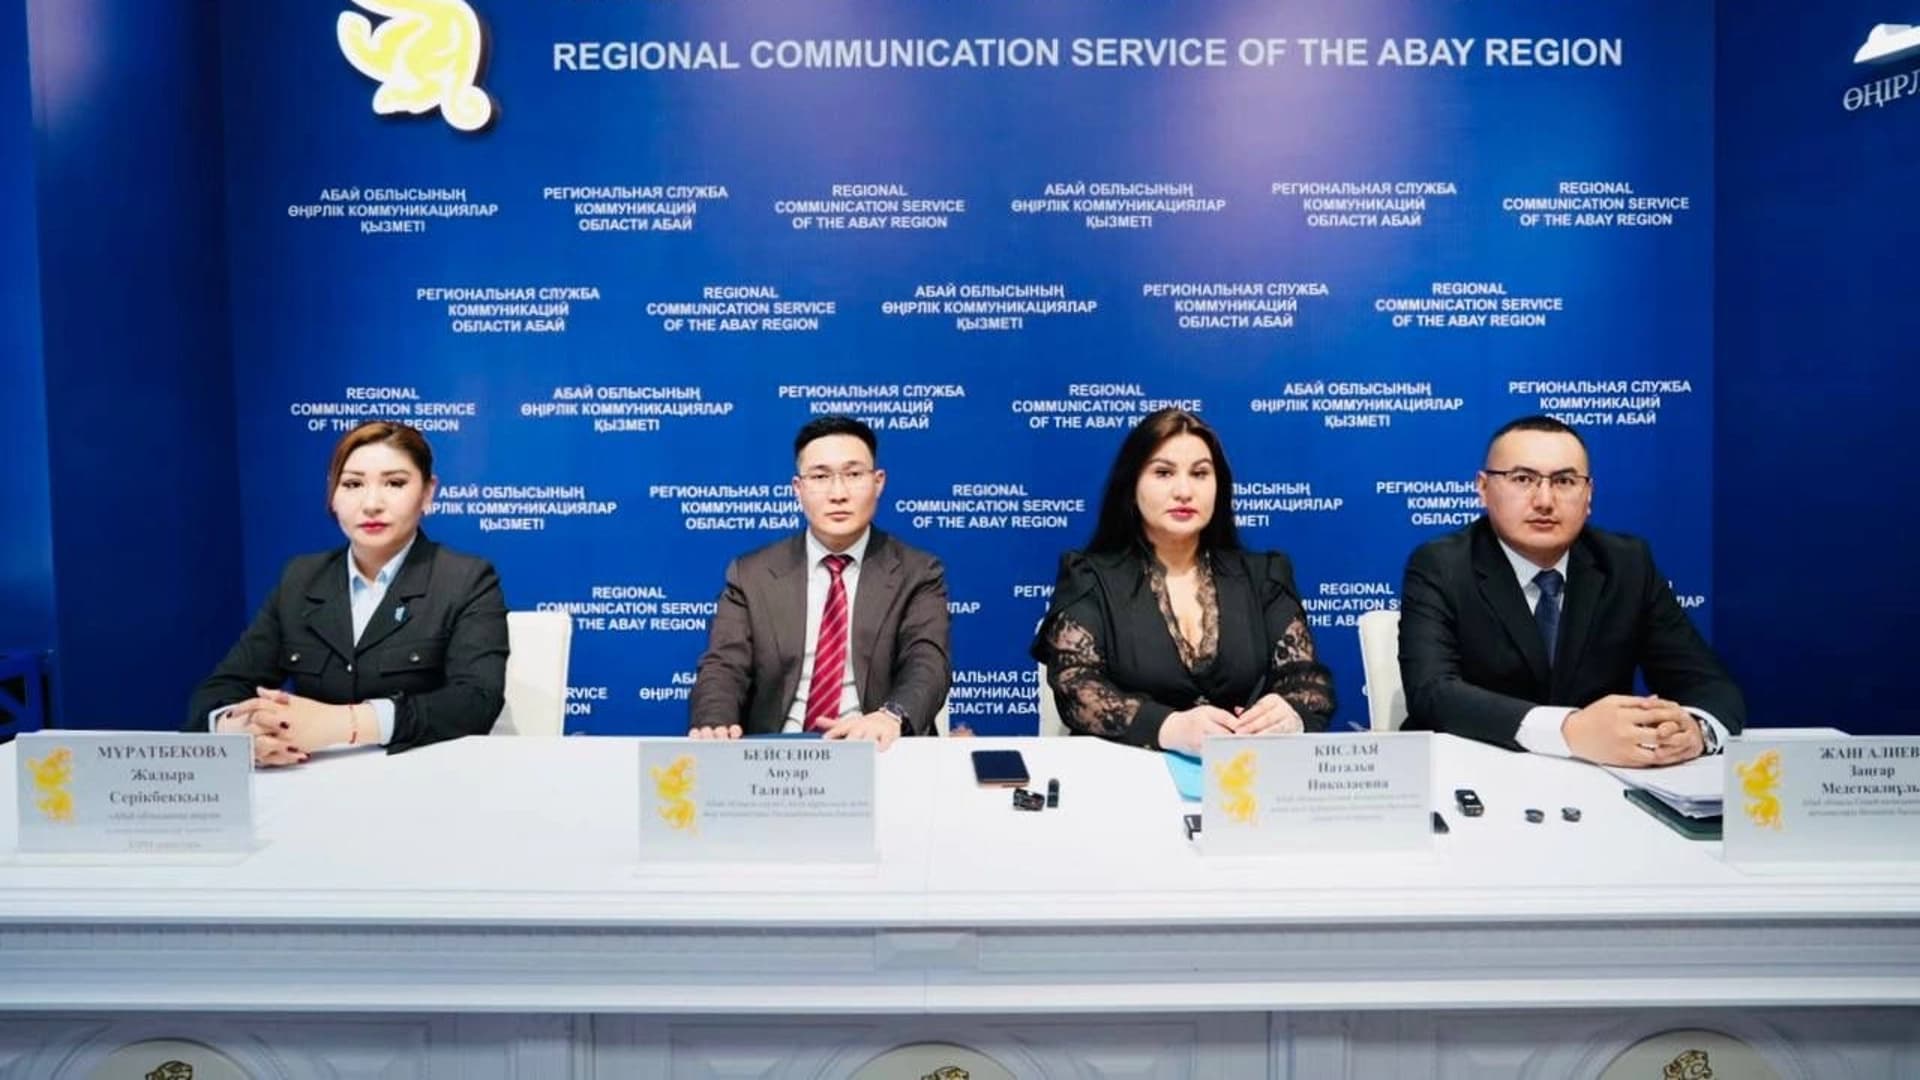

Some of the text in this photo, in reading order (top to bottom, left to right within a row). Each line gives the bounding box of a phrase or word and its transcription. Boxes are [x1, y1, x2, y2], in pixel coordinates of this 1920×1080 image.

[553, 37, 1622, 72] REGIONAL COMMUNICATION SERVICE OF THE ABAY REGION
[320, 187, 466, 202] АБАЙ ОБЛЫСЫНЫҢ
[544, 185, 728, 200] РЕГИОНАЛЬНАЯ СЛУЖБА
[832, 184, 907, 196] REGIONAL
[1044, 181, 1193, 197] АБАЙ ОБЛЫСЫНЫҢ
[1272, 182, 1457, 195] РЕГИОНАЛЬНАЯ СЛУЖБА
[1559, 182, 1633, 194] REGIONAL
[288, 204, 498, 218] ӨҢІРЛІК КОММУНИКАЦИЯЛАР
[575, 202, 696, 215] КОММУНИКАЦИЙ
[775, 200, 965, 213] COMMUNICATION SERVICE
[1011, 199, 1226, 214] ӨҢІРЛІК КОММУНИКАЦИЯЛАР
[1304, 199, 1425, 211] КОММУНИКАЦИЙ
[1502, 197, 1689, 211] COMMUNICATION SERVICE
[579, 216, 693, 231] ОБЛАСТИ АБАЙ
[792, 216, 948, 229] OF THE ABAY REGION
[1086, 216, 1152, 229] ҚЫЗМЕТІ
[1307, 212, 1422, 226] ОБЛАСТИ АБАЙ
[1520, 213, 1672, 227] OF THE ABAY REGION
[361, 221, 425, 234] ҚЫЗМЕТІ
[417, 287, 600, 301] РЕГИОНАЛЬНАЯ СЛУЖБА
[703, 286, 778, 298] REGIONAL
[914, 283, 1064, 298] АБАЙ ОБЛЫСЫНЫҢ
[1143, 283, 1329, 297] РЕГИОНАЛЬНАЯ СЛУЖБА
[1432, 282, 1507, 295] REGIONAL
[448, 302, 569, 316] КОММУНИКАЦИЙ
[646, 301, 836, 316] COMMUNICATION SERVICE
[881, 300, 1098, 316] ӨҢІРЛІК КОММУНИКАЦИЯЛАР
[1175, 300, 1296, 312] КОММУНИКАЦИЙ
[1374, 297, 1563, 312] COMMUNICATION SERVICE
[452, 317, 565, 333] ОБЛАСТИ АБАЙ
[664, 318, 818, 331] OF THE ABAY REGION
[956, 317, 1023, 332] ҚЫЗМЕТІ
[1179, 313, 1293, 328] ОБЛАСТИ АБАЙ
[1392, 314, 1546, 328] OF THE ABAY REGION
[346, 387, 420, 399] REGIONAL
[553, 384, 701, 401] АБАЙ ОБЛЫСЫНЫҢ
[778, 384, 966, 398] РЕГИОНАЛЬНАЯ СЛУЖБА
[1069, 384, 1145, 396] REGIONAL
[1284, 380, 1432, 396] АБАЙ ОБЛЫСЫНЫҢ
[1508, 380, 1692, 394] РЕГИОНАЛЬНАЯ СЛУЖБА
[810, 399, 933, 414] КОММУНИКАЦИЙ
[1012, 400, 1136, 412] COMMUNICATION
[1250, 398, 1464, 414] ӨҢІРЛІК КОММУНИКАЦИЯЛАР
[1540, 394, 1660, 409] КОММУНИКАЦИЙ
[290, 402, 478, 416] COMMUNICATION SERVICE
[520, 402, 734, 418] ӨҢІРЛІК КОММУНИКАЦИЯЛАР
[888, 416, 930, 430] АБАЙ
[1030, 417, 1049, 429] OF
[1054, 417, 1081, 428] THE
[1086, 416, 1123, 428] ABAY
[1324, 415, 1390, 429] ҚЫЗМЕТІ
[1616, 410, 1657, 424] АБАЙ
[308, 419, 328, 431] OF
[594, 419, 660, 433] ҚЫЗМЕТІ
[440, 484, 585, 500] АБАЙ ОБЛЫСЫНЫҢ
[649, 485, 769, 498] РЕГИОНАЛЬНАЯ
[952, 484, 1028, 496] REGIONAL
[1376, 481, 1479, 494] РЕГИОНАЛЬН
[467, 501, 618, 515] КОММУНИКАЦИЯЛАР
[681, 500, 804, 514] КОММУНИКАЦИЙ
[895, 499, 1085, 512] COMMUNICATION SERVICE
[1231, 498, 1344, 512] УНИКАЦИЯЛАР
[1407, 497, 1483, 510] КОММУНИ
[480, 518, 544, 532] ҚЫЗМЕТІ
[685, 517, 798, 530] ОБЛАСТИ АБАЙ
[912, 516, 1067, 528] OF THE ABAY REGION
[1234, 514, 1270, 527] МЕТІ
[592, 586, 666, 598] REGIONAL
[1320, 583, 1394, 595] REGIONAL
[537, 603, 657, 615] COMMUNICATION
[577, 618, 706, 630] THE ABAY REGION
[566, 687, 608, 700] RVICE
[639, 687, 692, 702] ӨҢІРЛІ
[949, 703, 1003, 714] БЛАСТИ
